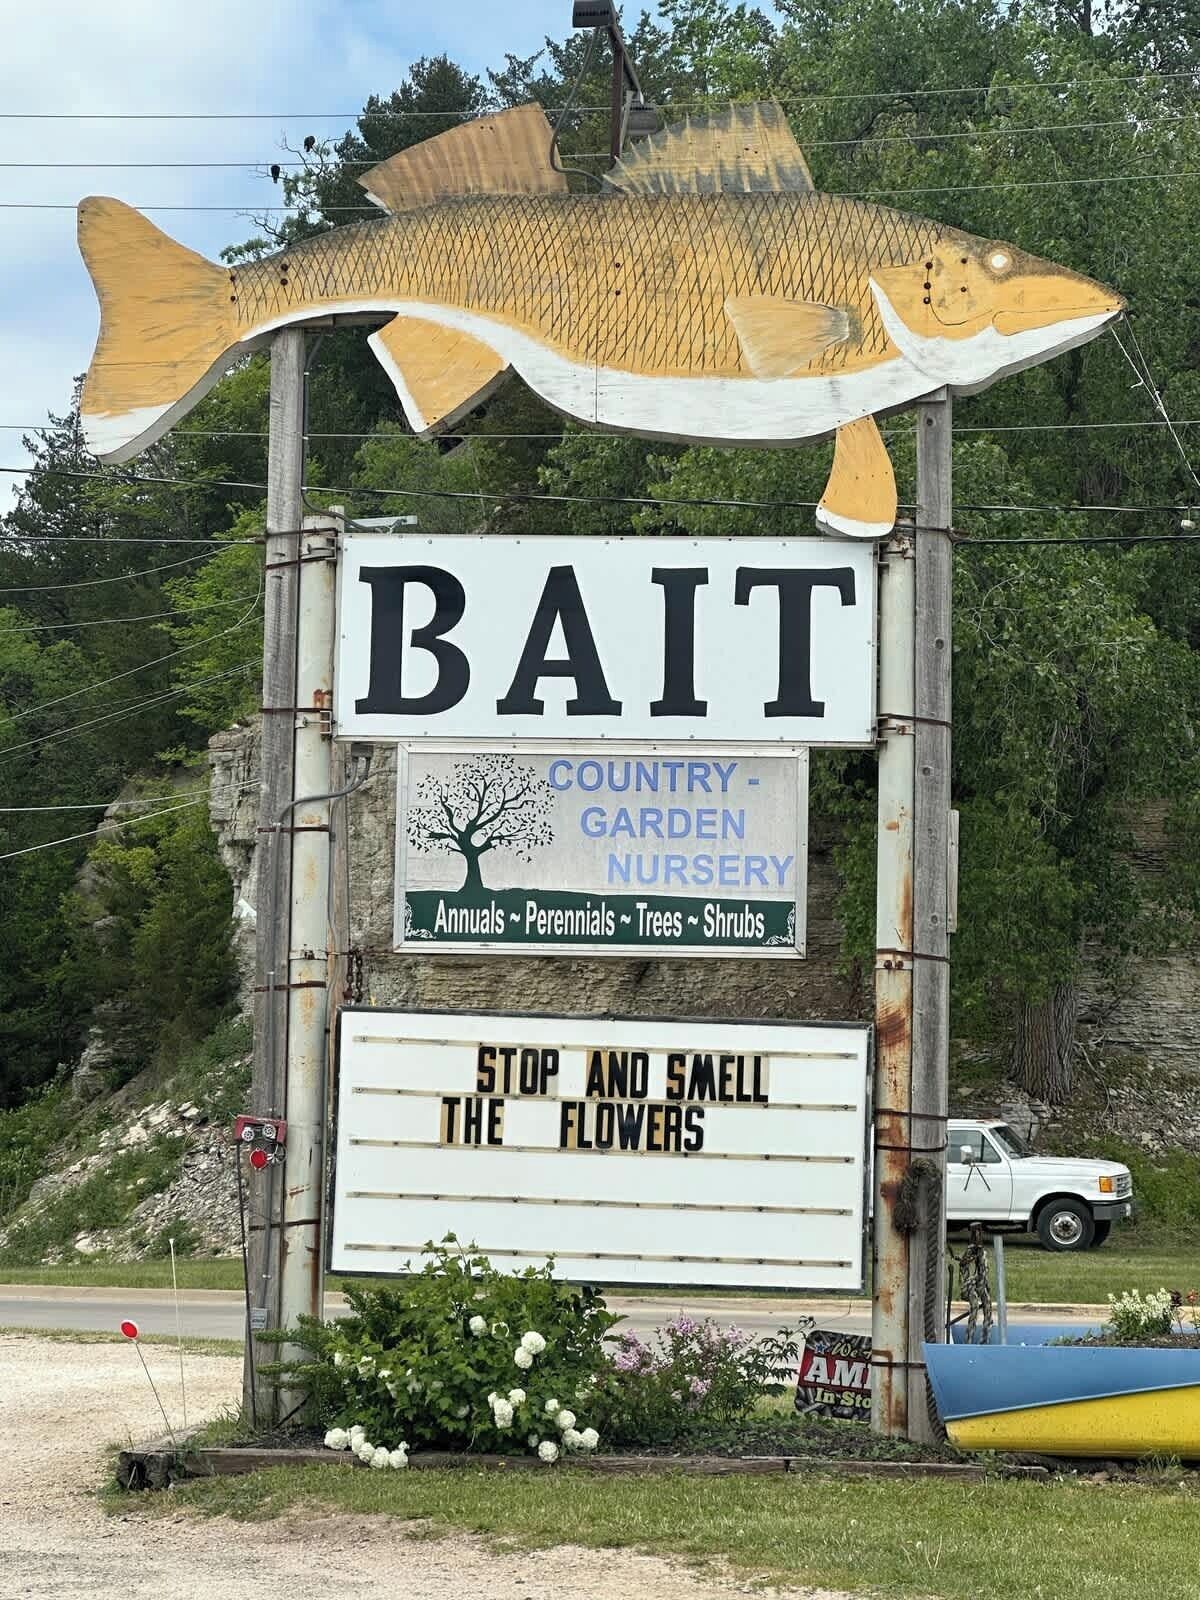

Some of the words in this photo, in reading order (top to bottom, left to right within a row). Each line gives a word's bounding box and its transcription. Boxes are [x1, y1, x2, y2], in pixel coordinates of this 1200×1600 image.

[355, 564, 856, 718] BAIT
[548, 759, 738, 792] COUNTRY
[580, 807, 745, 840] GARDEN
[608, 853, 794, 887] NURSERY
[434, 899, 505, 935] Annuals
[525, 901, 615, 937] Perennials
[636, 902, 683, 937] Trees
[703, 903, 765, 939] Shrubs
[477, 1046, 560, 1095] STOP
[586, 1050, 649, 1099] AND
[666, 1053, 769, 1102] SMELL
[442, 1097, 505, 1145] THE
[560, 1101, 705, 1152] FLOWERS
[804, 1356, 872, 1390] AM
[815, 1387, 835, 1404] In
[841, 1391, 872, 1409] Sto
